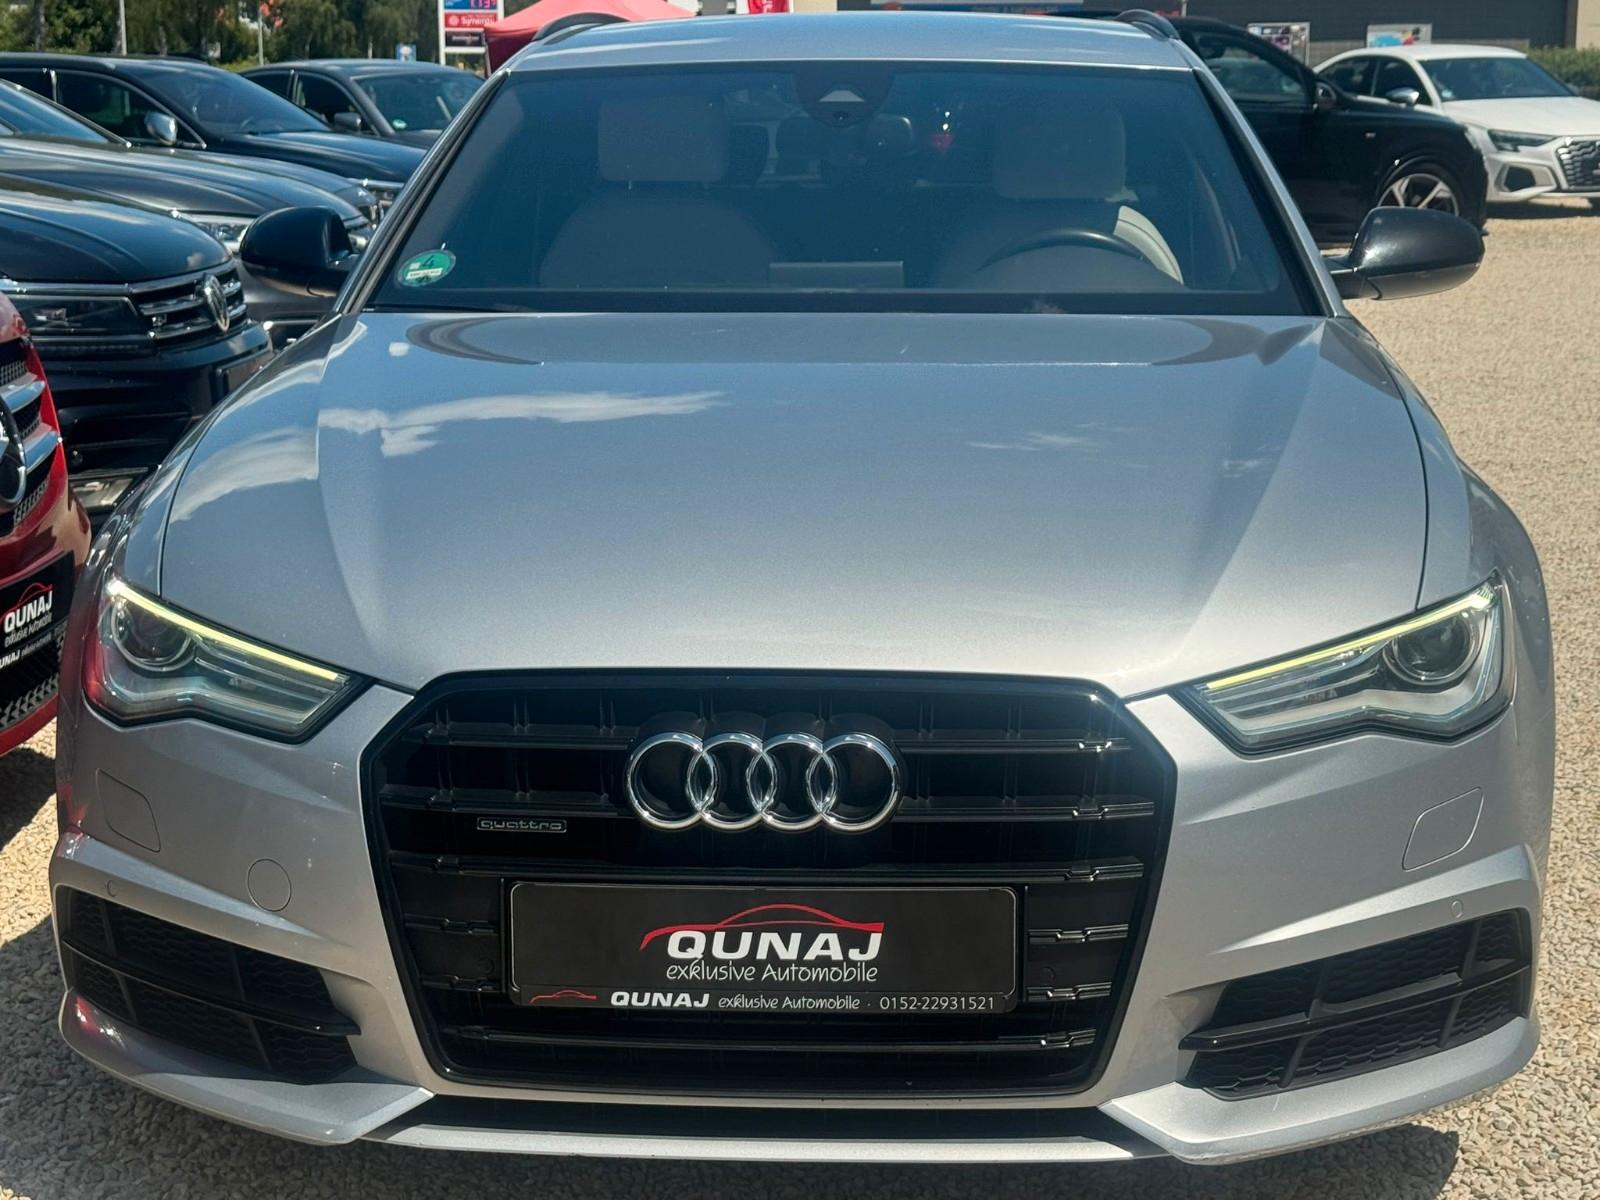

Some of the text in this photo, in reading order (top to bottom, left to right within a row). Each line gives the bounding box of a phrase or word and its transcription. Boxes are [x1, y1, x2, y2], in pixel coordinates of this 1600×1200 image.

[4, 590, 53, 634] QUNAJ
[0, 649, 20, 670] UNAJ
[480, 820, 562, 831] quattro
[666, 930, 883, 961] QUNAJ
[666, 959, 878, 982] exklusive Automobile
[610, 991, 995, 1011] QUNAJ exklusive Automobile 0152-22931521
